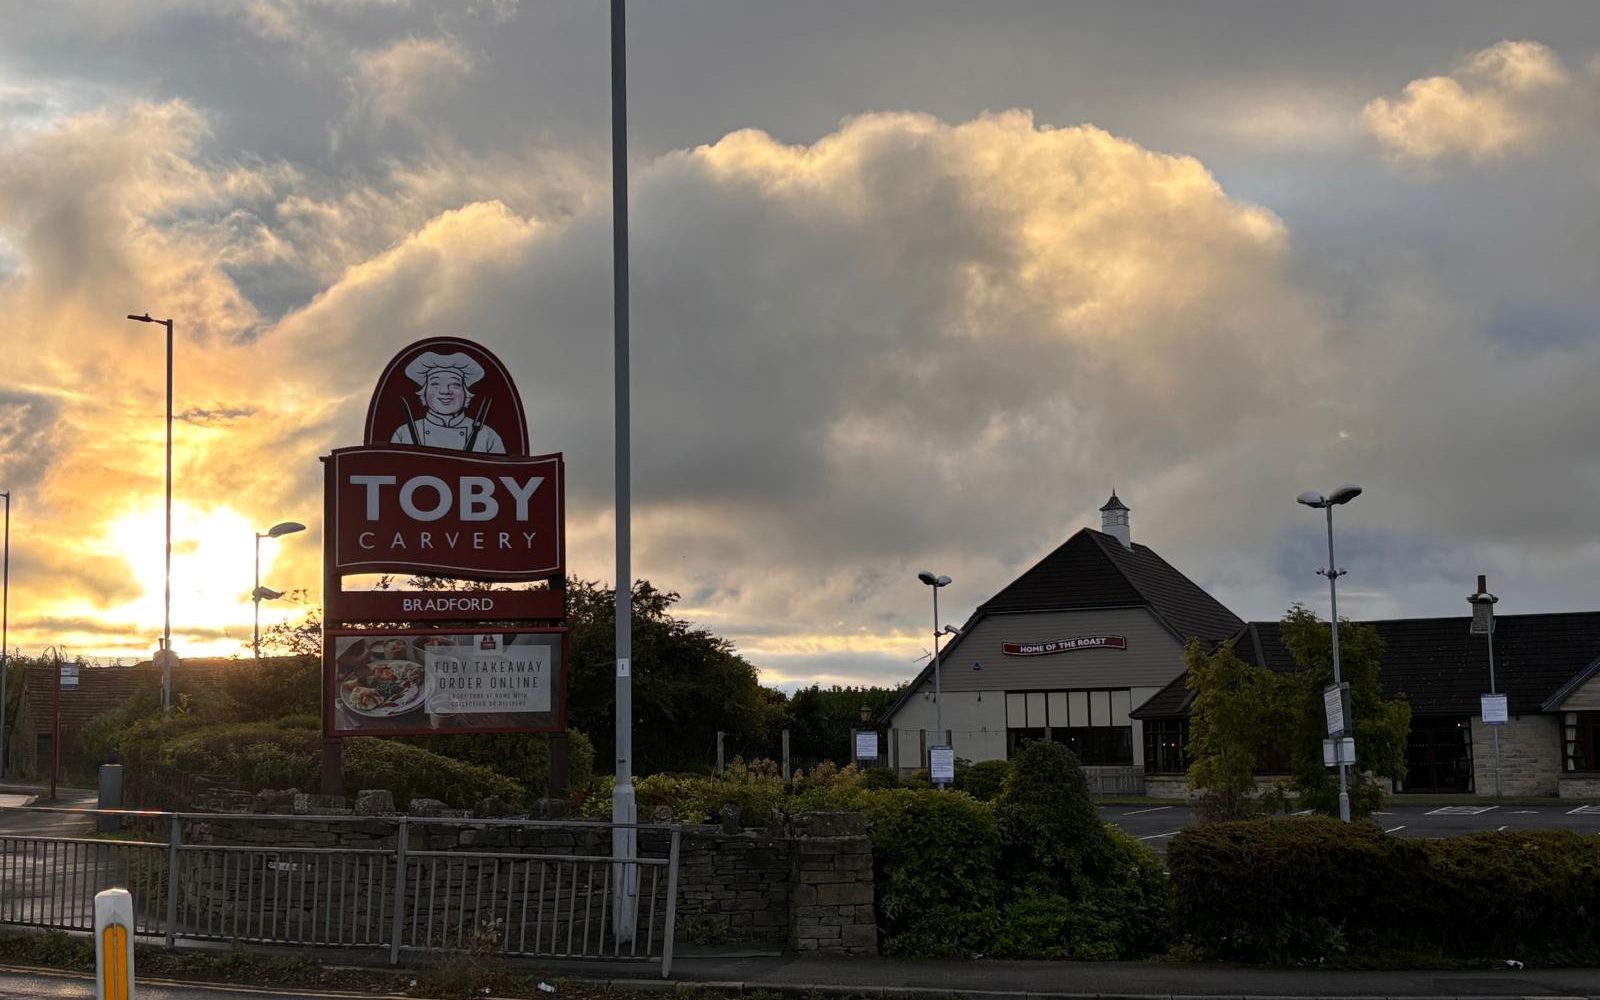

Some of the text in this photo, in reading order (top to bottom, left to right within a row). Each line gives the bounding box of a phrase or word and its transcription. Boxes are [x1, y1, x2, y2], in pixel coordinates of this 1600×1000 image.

[350, 475, 545, 522] TOBY
[359, 532, 536, 549] CARVERY
[403, 598, 494, 612] BRADFORD
[1020, 645, 1044, 653] HOME
[1058, 641, 1076, 649] THE
[1077, 638, 1106, 646] ROAST
[434, 661, 542, 673] TOBY TAKEAWAY
[439, 676, 538, 689] ORDER ONLINE
